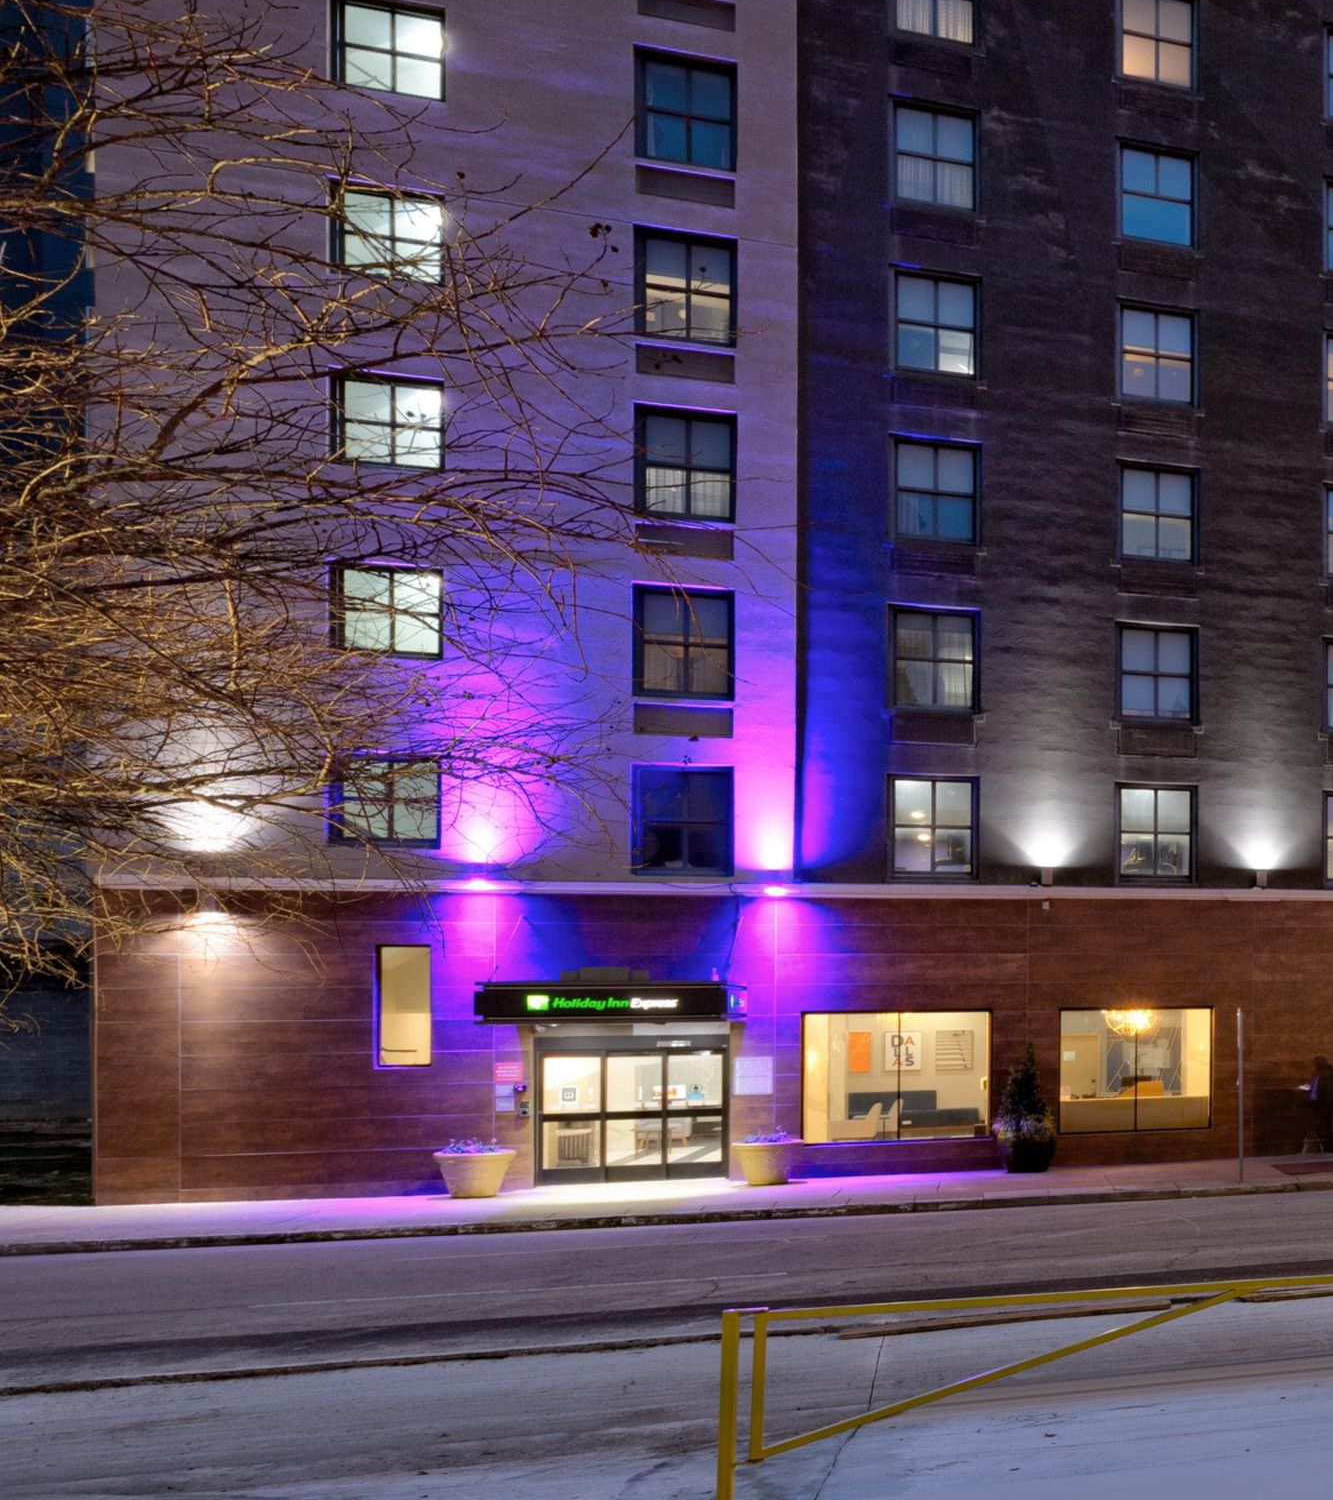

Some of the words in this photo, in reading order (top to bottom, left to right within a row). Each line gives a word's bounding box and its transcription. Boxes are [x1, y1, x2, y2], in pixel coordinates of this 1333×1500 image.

[552, 996, 606, 1011] Holiday
[607, 997, 629, 1009] Inn
[629, 997, 680, 1011] Express
